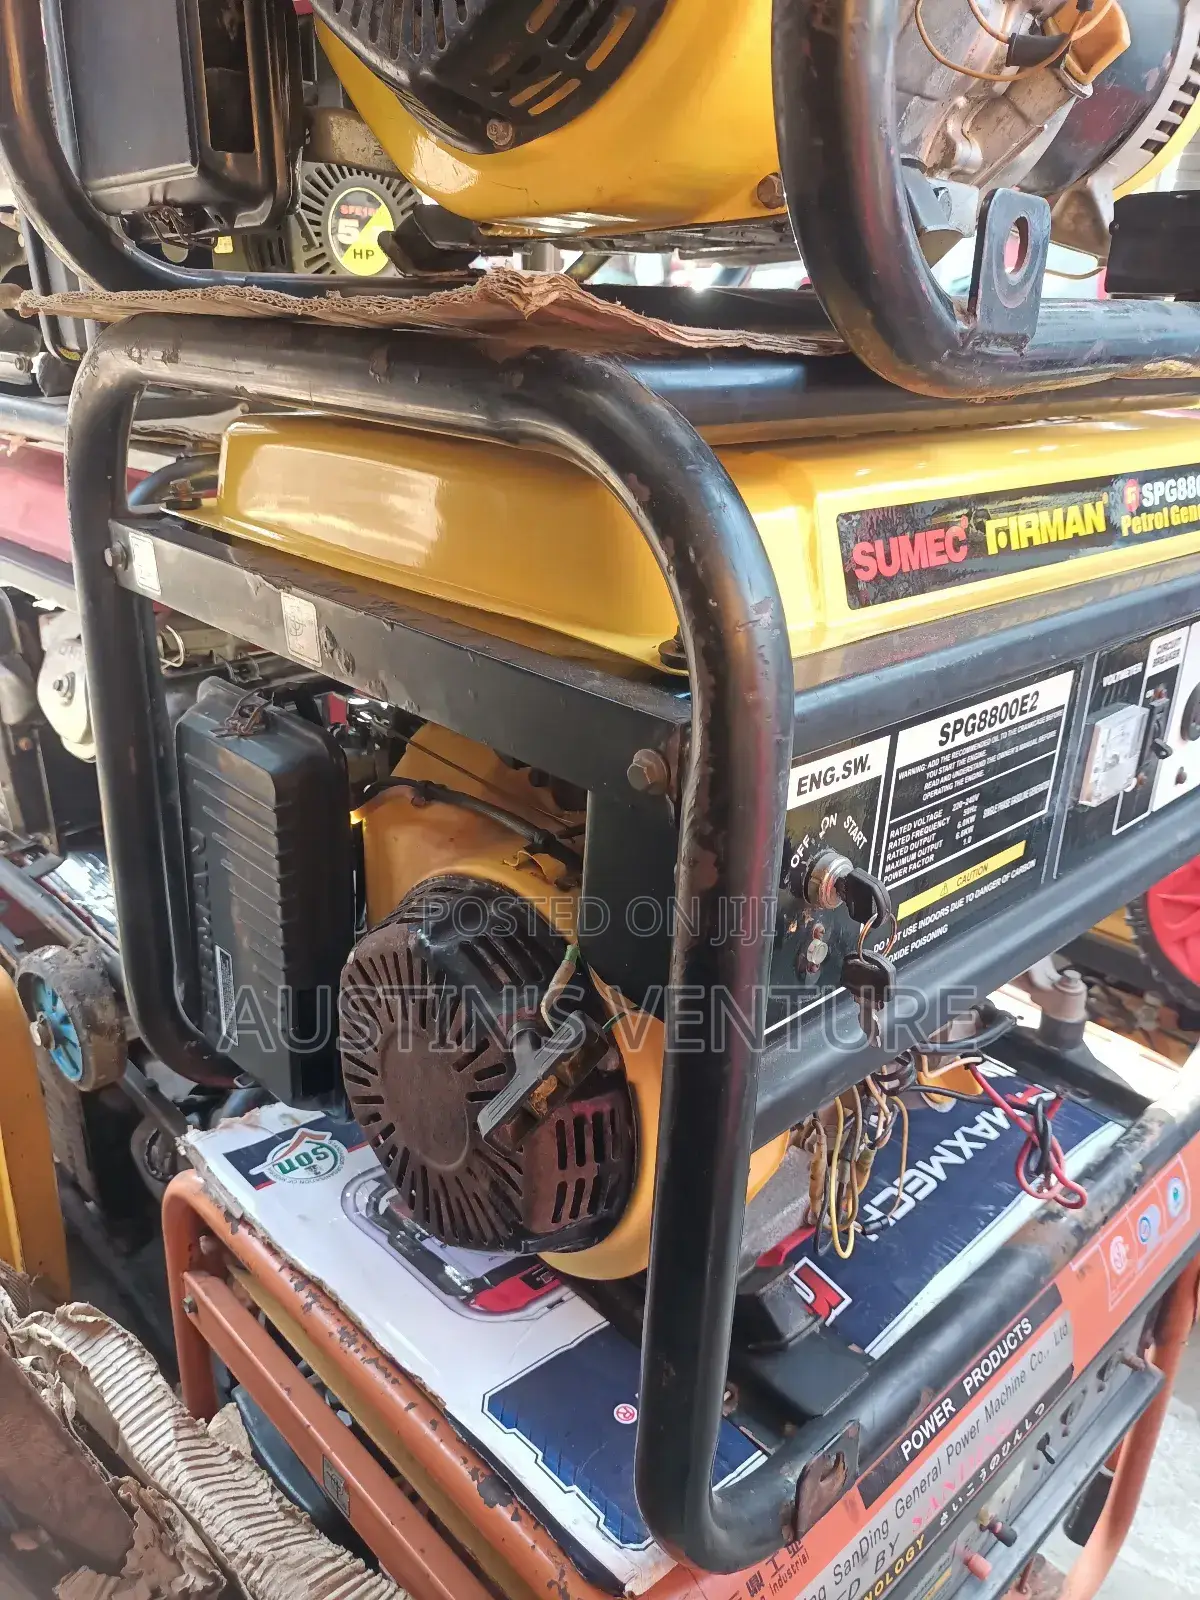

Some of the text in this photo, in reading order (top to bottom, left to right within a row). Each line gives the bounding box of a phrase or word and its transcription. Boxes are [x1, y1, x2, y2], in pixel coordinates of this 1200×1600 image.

[353, 248, 374, 260] HP
[1121, 507, 1169, 536] Petrol
[852, 501, 1106, 582] SUMEC FIRMAN
[938, 690, 1040, 747] SPG8800E2
[796, 754, 872, 797] ENG.SW.
[924, 779, 940, 790] READ
[940, 774, 952, 784] AND
[952, 759, 986, 779] UNDERSTAND
[987, 755, 996, 764] THE
[926, 770, 938, 779] YOU
[938, 762, 956, 774] START
[957, 758, 966, 767] THE
[927, 758, 939, 769] ADD
[941, 754, 951, 763] THE
[922, 783, 953, 801] OPERATING
[954, 778, 964, 787] THE
[790, 812, 868, 868] OFF ON START
[888, 833, 911, 850] RATED
[911, 816, 951, 838] FREQUENCY
[889, 822, 912, 839] RATED
[913, 809, 944, 829] VOLTAGE
[884, 854, 917, 873] MAXIMUM
[917, 840, 943, 860] OUTPUT
[886, 845, 909, 862] RATED
[909, 833, 936, 851] OUTPUT
[883, 868, 909, 884] POWER
[909, 854, 935, 871] FACTOR
[957, 863, 988, 887] CAUTION
[873, 941, 885, 953] DO
[903, 922, 918, 939] USE
[918, 906, 950, 931] INDOORS
[950, 898, 964, 913] DUE
[965, 892, 974, 903] TO
[975, 877, 1002, 899] DANGER
[1002, 872, 1011, 884] OF
[1011, 859, 1036, 878] CARBON
[887, 924, 948, 964] OXIDE POISONING
[900, 1397, 956, 1462] POWER
[962, 1318, 1032, 1396] PRODUCTS
[833, 1518, 889, 1585] SanDing
[895, 1457, 942, 1519] General
[946, 1419, 980, 1465] Power
[984, 1370, 1026, 1423] Machine
[874, 1532, 900, 1575] BY
[768, 1548, 810, 1597] Industrial
